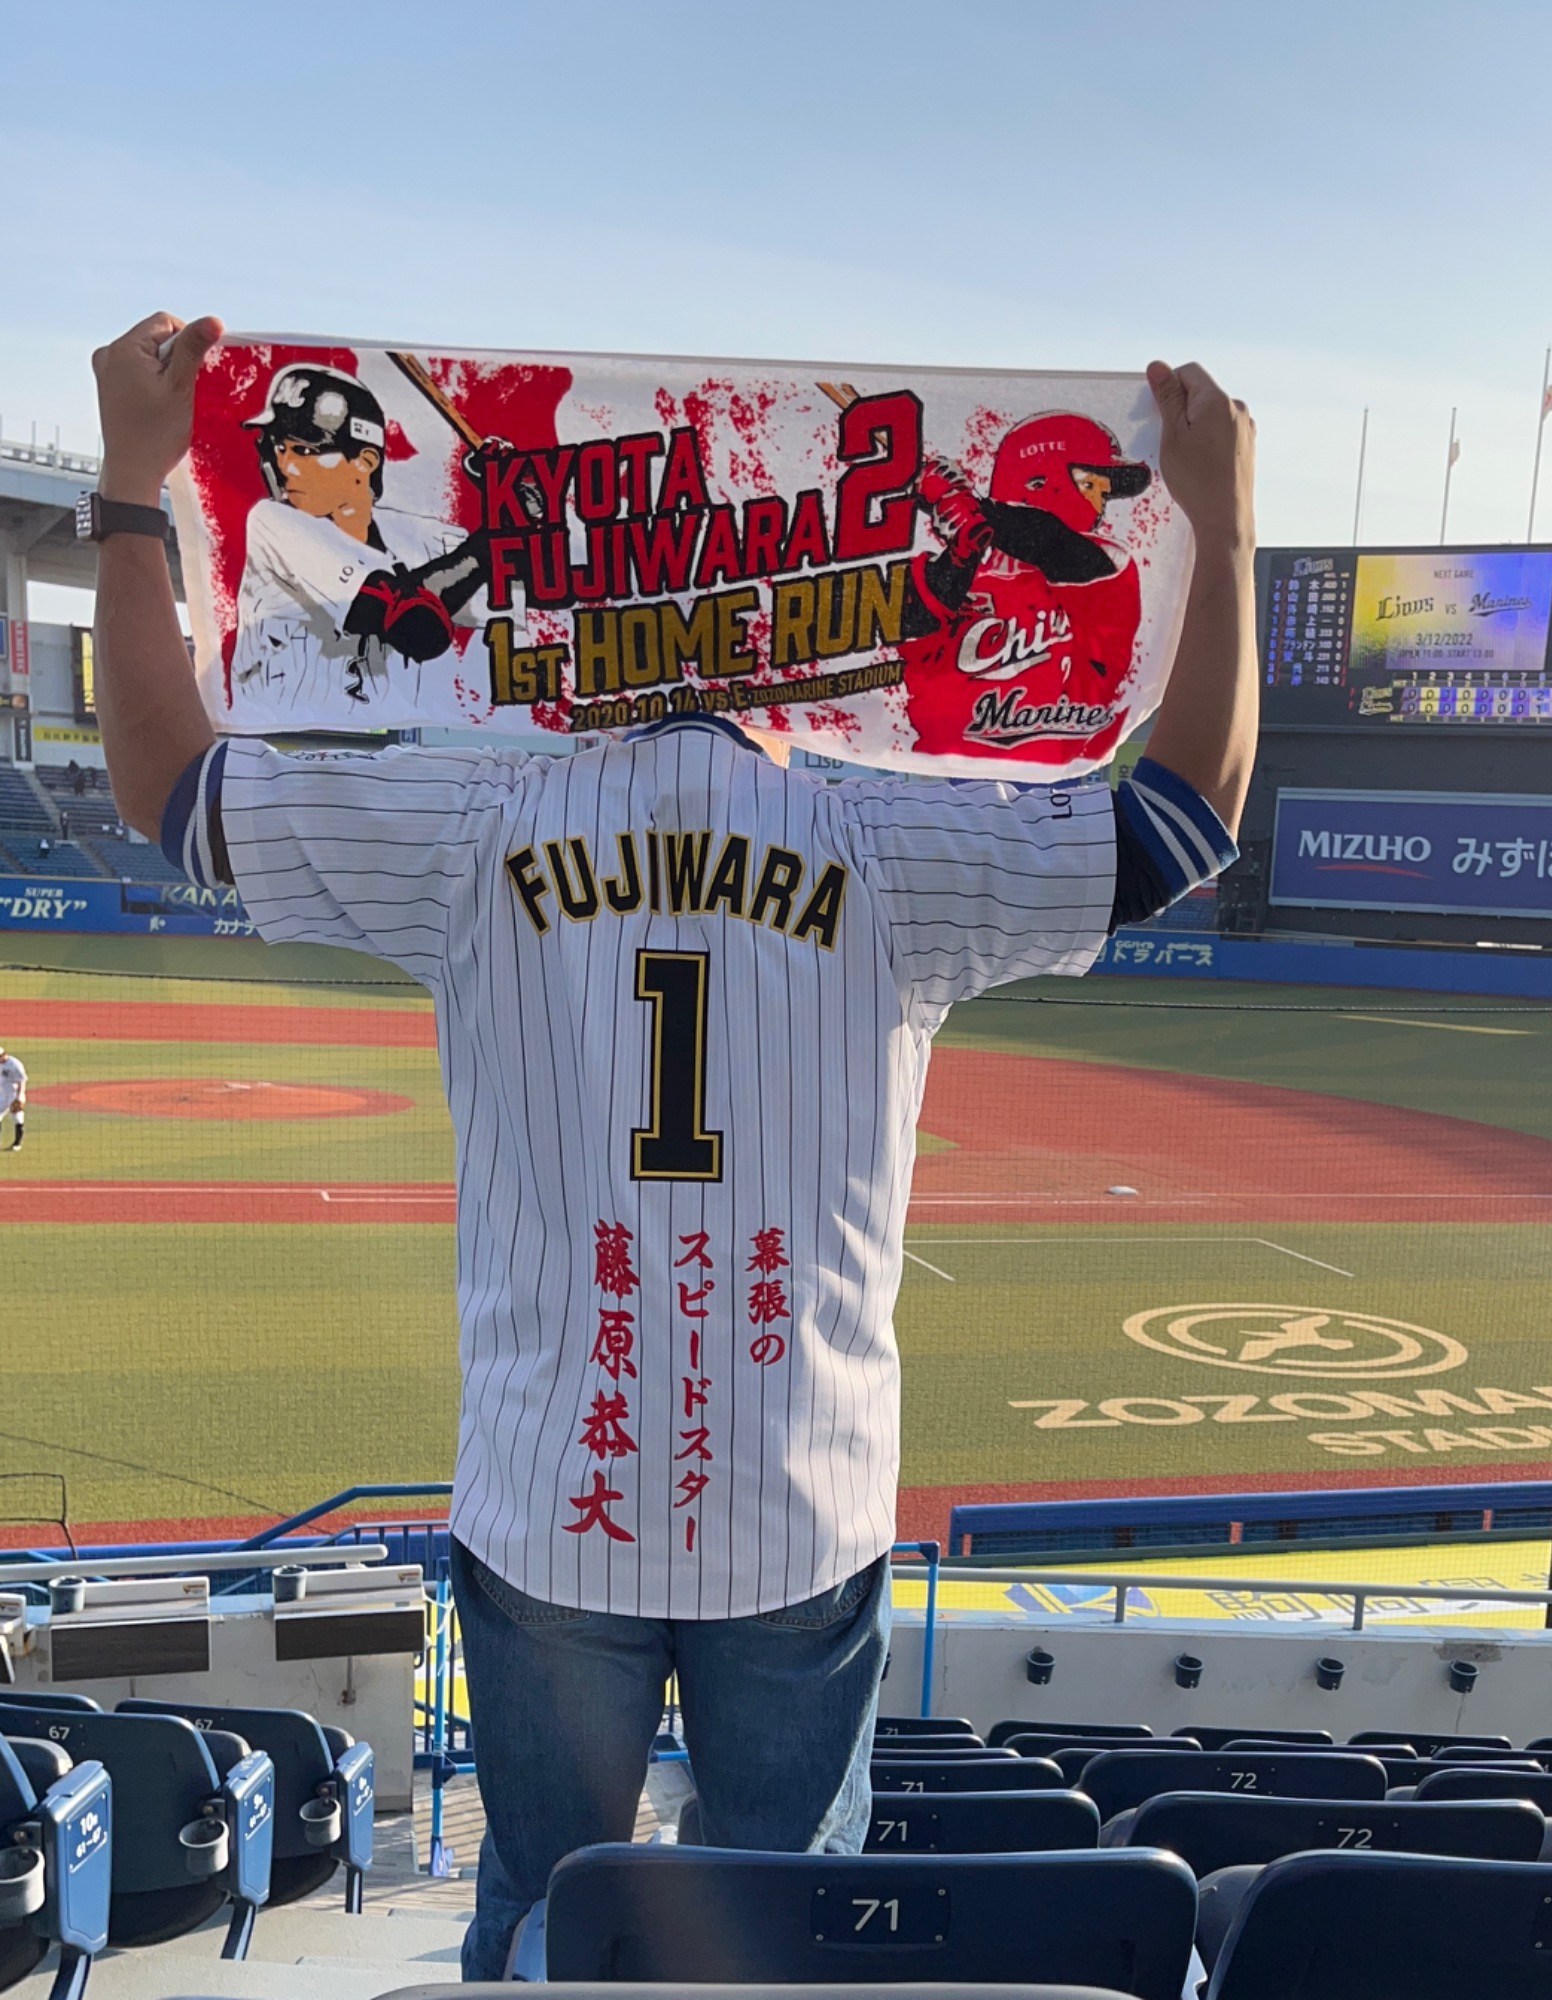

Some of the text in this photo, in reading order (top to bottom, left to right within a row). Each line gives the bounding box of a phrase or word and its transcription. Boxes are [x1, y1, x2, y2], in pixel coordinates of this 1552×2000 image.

[1020, 440, 1066, 459] LOTTE
[485, 428, 706, 531] KYOTA
[835, 391, 923, 564] 2
[486, 490, 830, 611] FUJIWARA
[1433, 570, 1453, 579] NEXT
[1376, 595, 1435, 621] Lions
[1468, 591, 1532, 617] Marines
[574, 588, 761, 697] HOME
[770, 556, 914, 668] RUN
[1415, 632, 1474, 646] 3/12/2022
[732, 683, 747, 707] E
[752, 677, 835, 704] ZOZOMARINE
[837, 663, 901, 694] STADIUM
[1426, 689, 1434, 699] 0
[1462, 690, 1470, 700] 0
[1499, 690, 1508, 700] 0
[963, 687, 1115, 744] Marines
[1425, 703, 1433, 713] 0
[1461, 703, 1469, 713] 0
[1498, 704, 1506, 714] 0
[1297, 830, 1433, 862] MIZUHO
[24, 886, 64, 897] SUPER
[504, 829, 849, 953] FUJIWARA
[630, 948, 724, 1183] 1
[744, 1227, 792, 1366] 幕張の
[561, 1219, 640, 1543] 藤原恭大
[673, 1230, 714, 1553] スピードスター
[48, 1726, 70, 1740] 67
[195, 1719, 213, 1730] 67
[901, 1781, 925, 1793] 71
[1230, 1772, 1257, 1789] 72
[877, 1820, 908, 1842] 71
[1337, 1828, 1373, 1849] 72
[852, 1898, 899, 1931] 71
